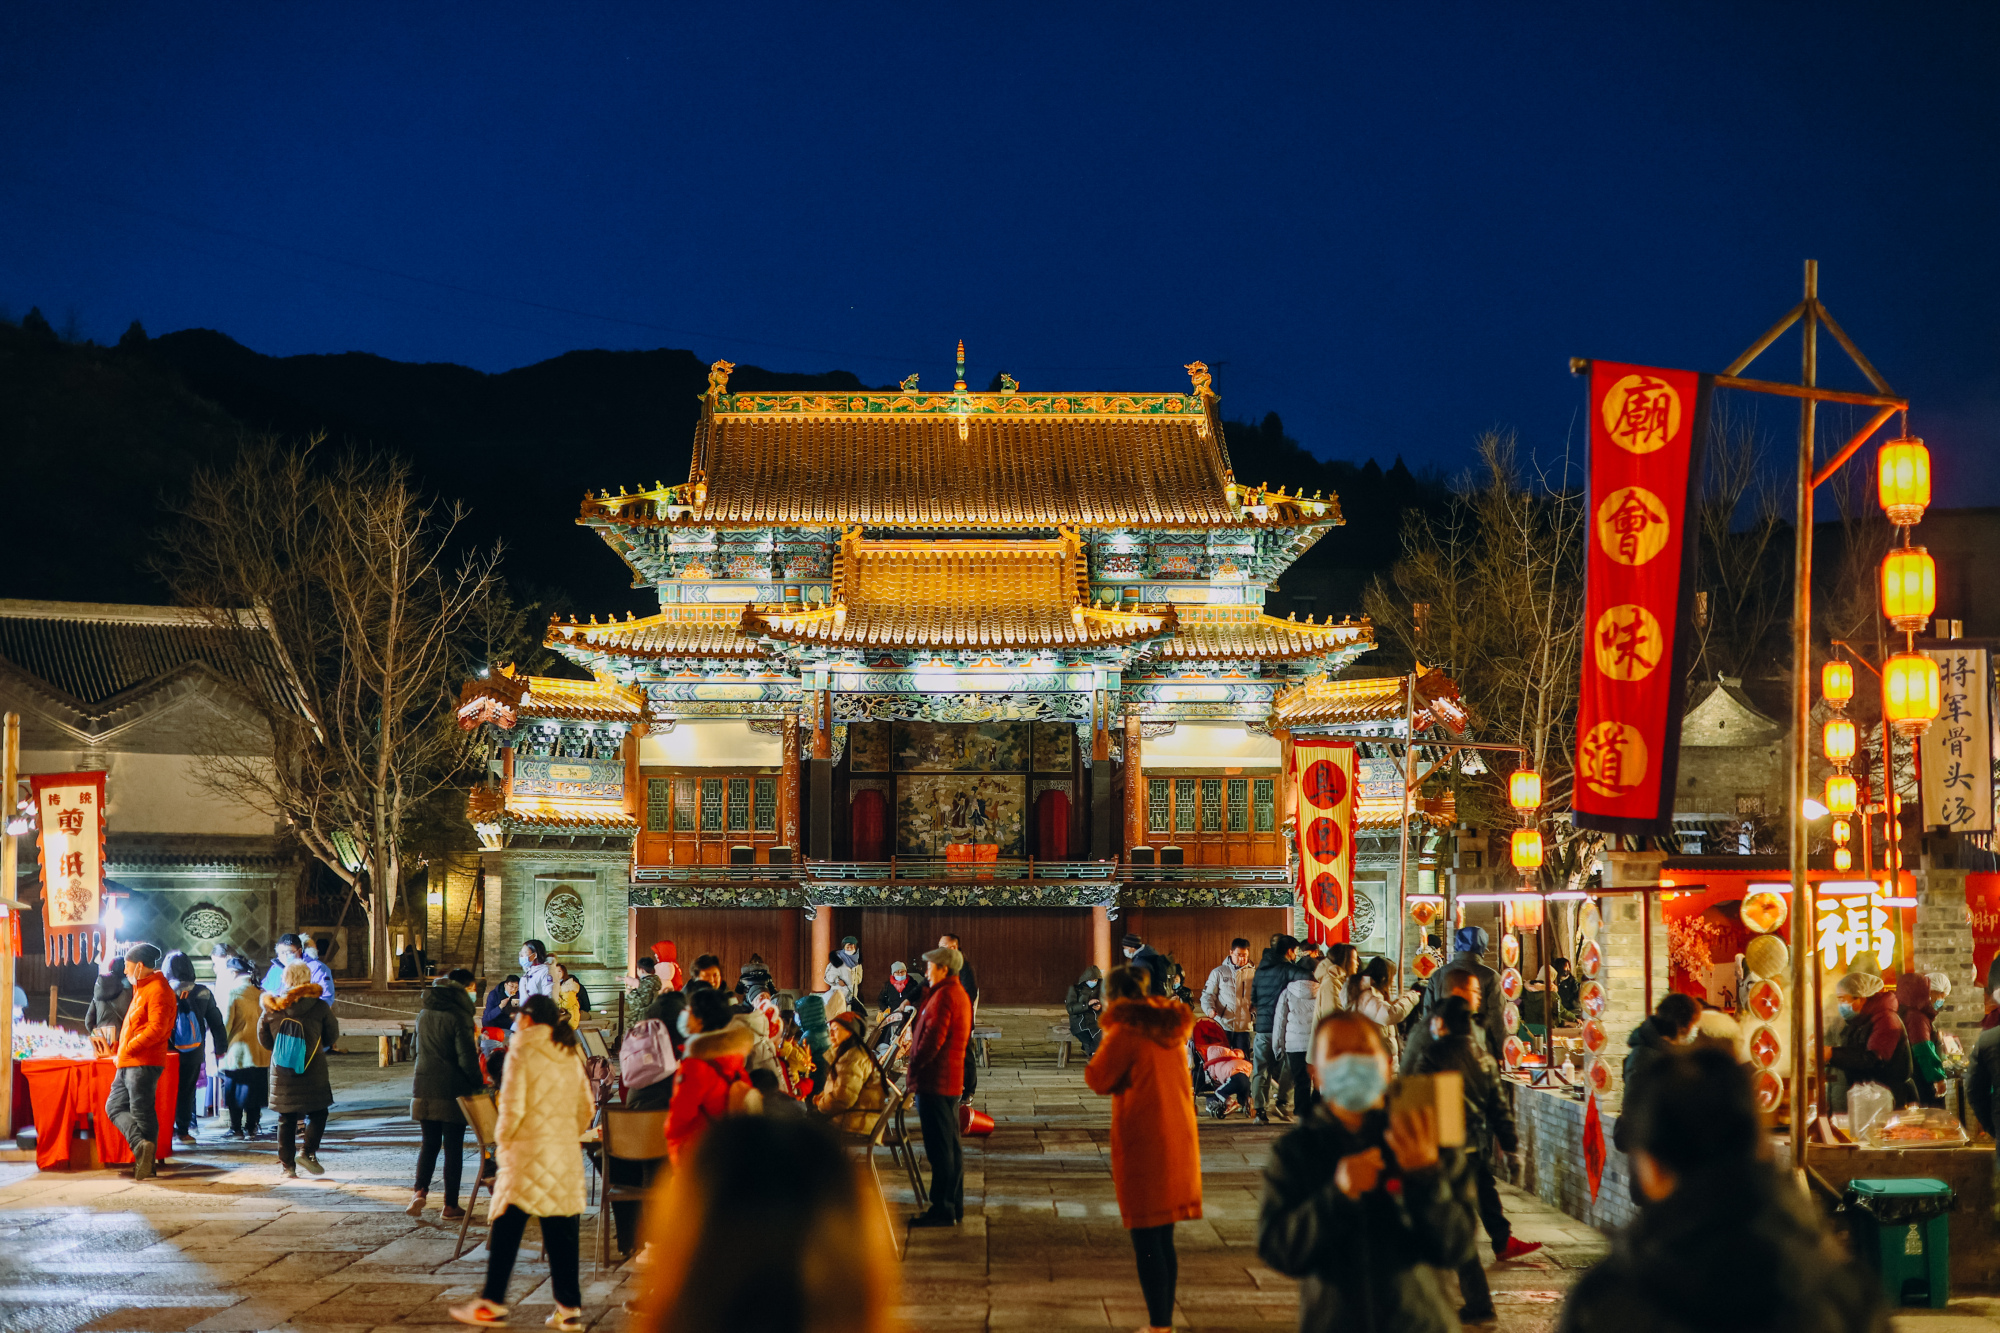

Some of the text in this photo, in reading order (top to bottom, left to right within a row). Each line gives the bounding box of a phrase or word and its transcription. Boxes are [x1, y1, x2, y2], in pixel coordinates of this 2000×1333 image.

[1584, 375, 1669, 794] 廟會味道
[1941, 656, 1976, 825] 将军骨头汤
[48, 792, 92, 806] 传统
[57, 808, 85, 878] 剪纸
[1816, 893, 1895, 970] 福
